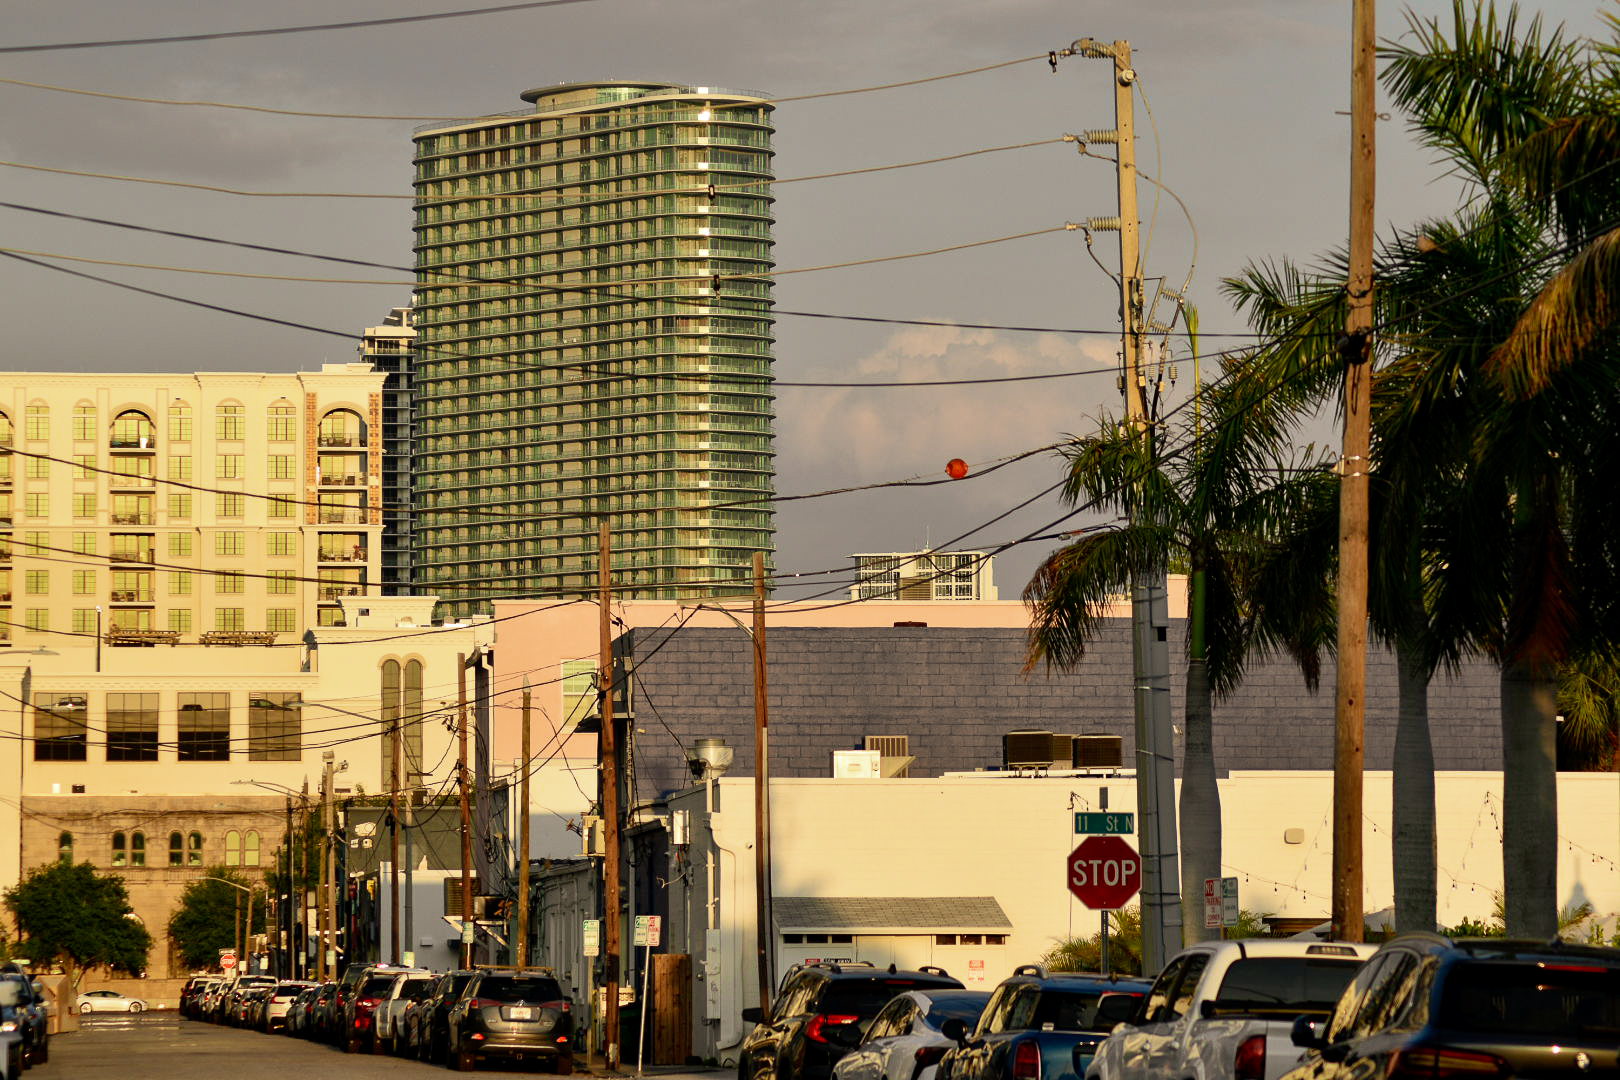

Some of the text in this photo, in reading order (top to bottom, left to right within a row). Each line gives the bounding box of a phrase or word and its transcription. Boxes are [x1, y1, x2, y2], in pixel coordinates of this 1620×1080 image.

[1078, 815, 1133, 832] 11 St N
[1073, 859, 1136, 886] STOP
[1205, 882, 1214, 894] NO
